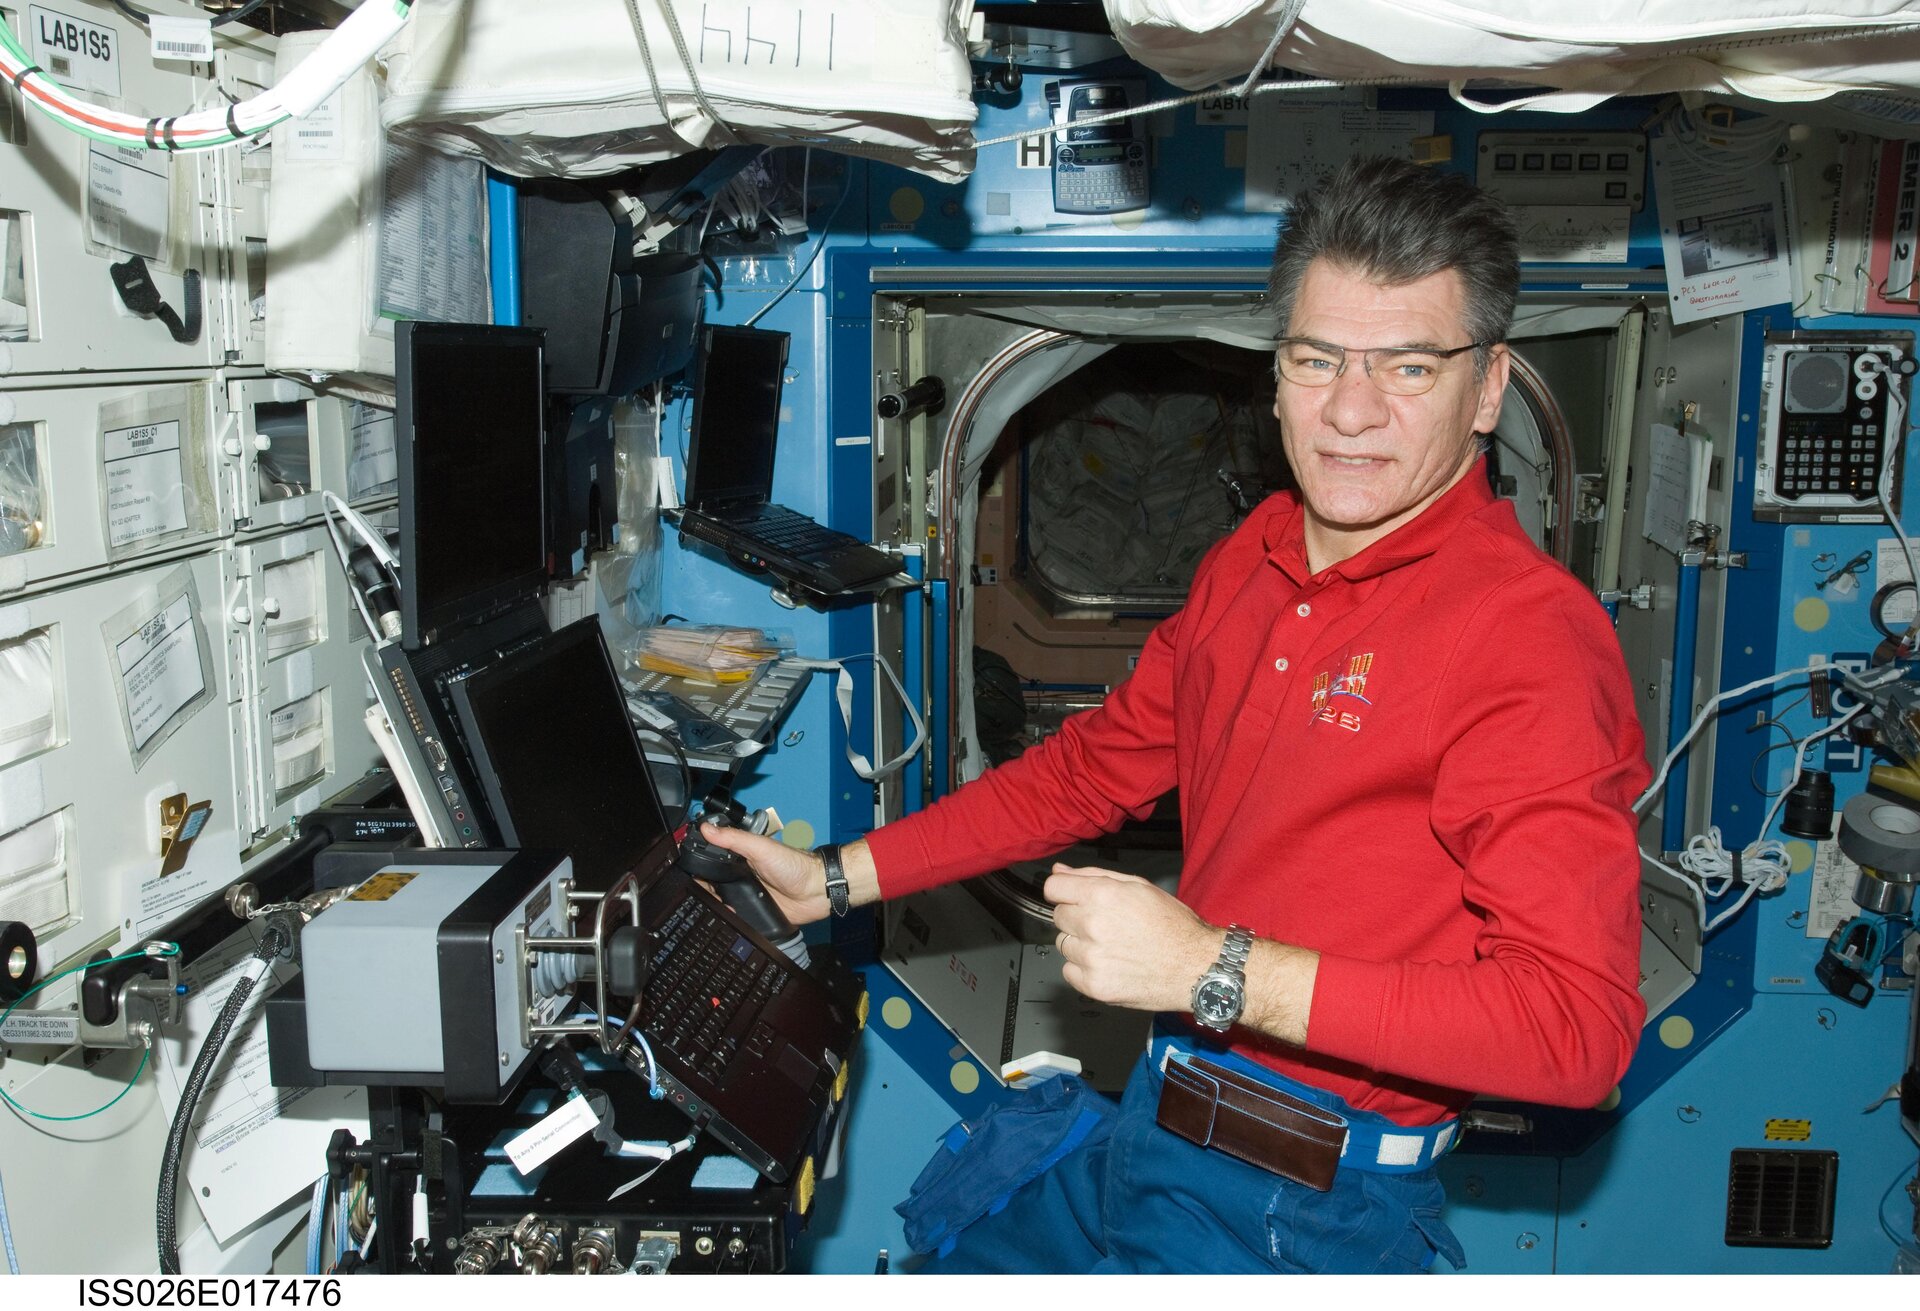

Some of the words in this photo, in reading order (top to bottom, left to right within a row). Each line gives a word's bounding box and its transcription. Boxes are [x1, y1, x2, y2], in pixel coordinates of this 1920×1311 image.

[40, 15, 112, 62] LAB1S5
[1897, 142, 1920, 233] EMER
[1826, 200, 1839, 265] HANDOVER
[1894, 243, 1909, 262] 2
[1681, 285, 1696, 296] PCS
[1318, 706, 1361, 732] 26
[5, 1020, 17, 1028] L.H.
[17, 1020, 38, 1028] TRACK
[39, 1020, 49, 1028] TIE
[49, 1020, 69, 1028] DOWN
[52, 1029, 74, 1038] SN1003
[513, 1153, 522, 1161] To
[520, 1147, 531, 1158] Any
[533, 1137, 543, 1148] Pin
[541, 1129, 556, 1143] Serial
